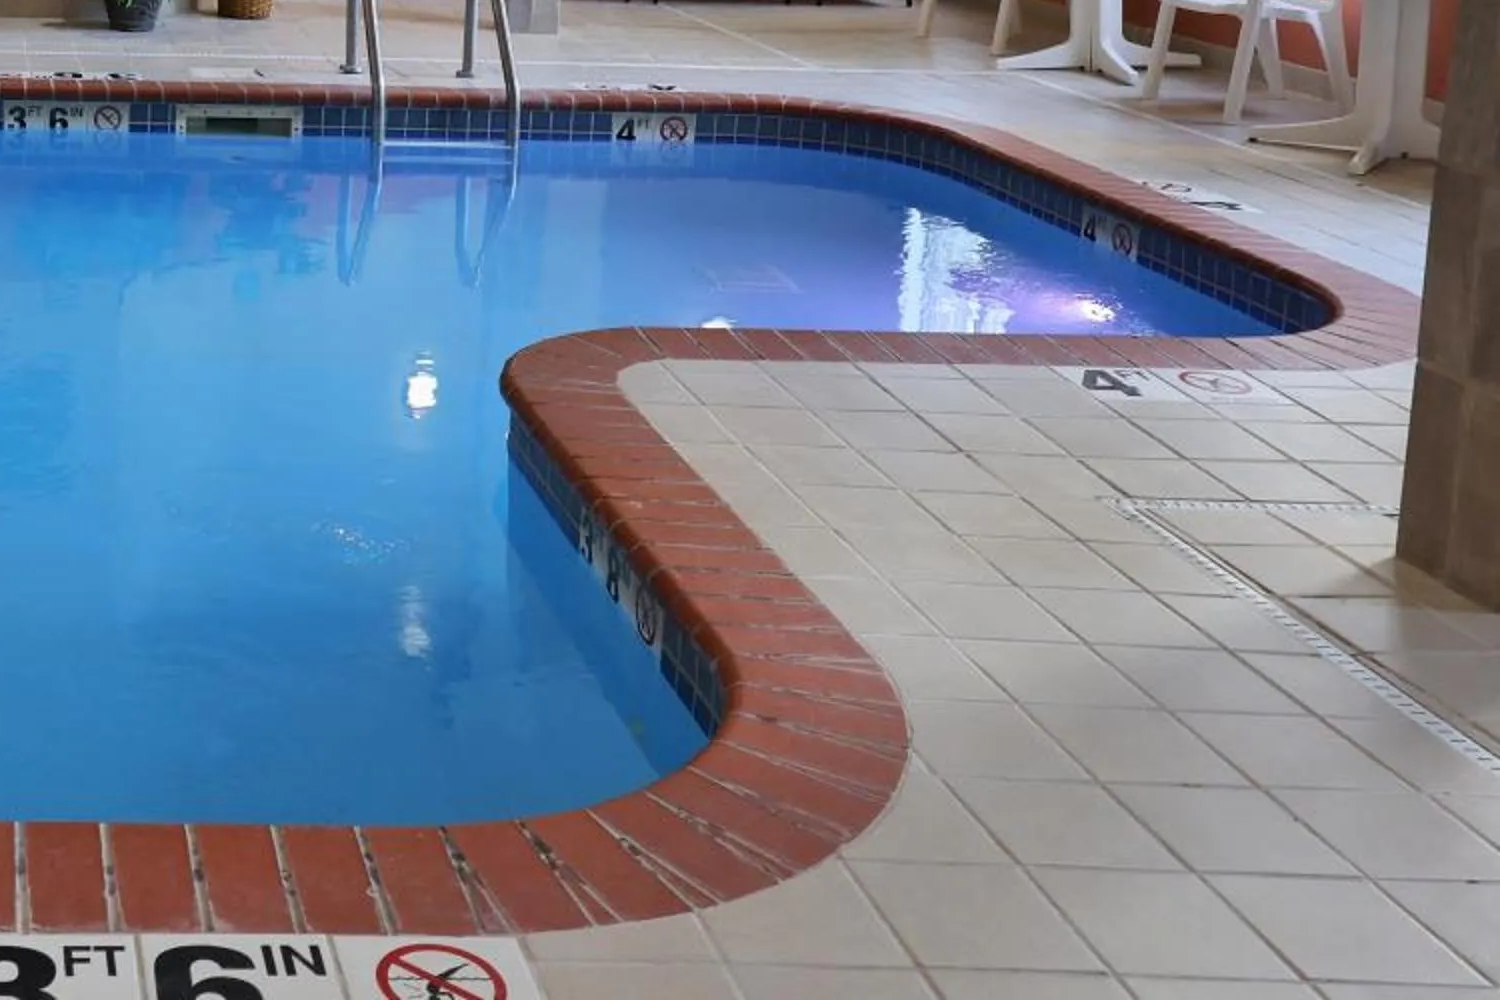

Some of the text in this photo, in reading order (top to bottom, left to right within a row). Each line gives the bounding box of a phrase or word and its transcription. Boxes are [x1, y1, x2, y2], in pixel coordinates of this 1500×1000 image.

[615, 118, 637, 141] 4
[1082, 369, 1142, 397] 4
[62, 945, 125, 977] FT
[154, 945, 263, 1000] 6
[261, 944, 327, 977] IN
